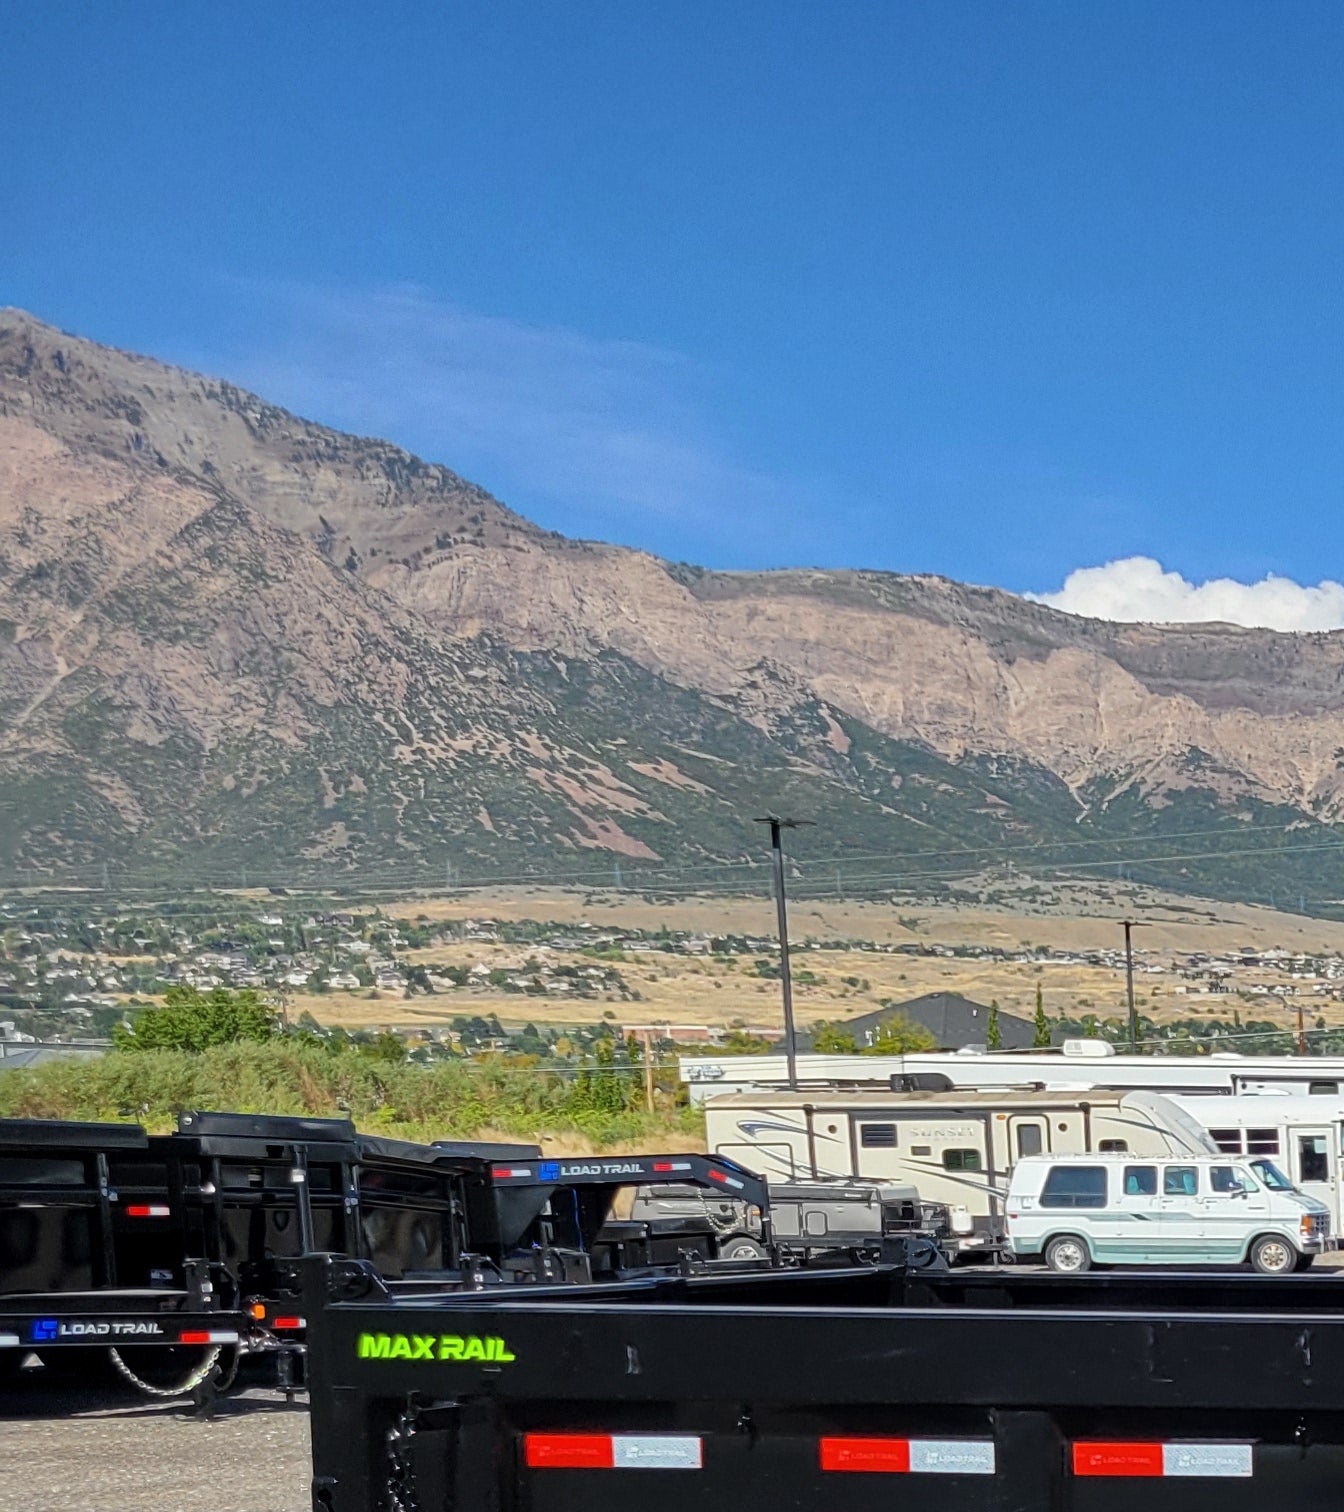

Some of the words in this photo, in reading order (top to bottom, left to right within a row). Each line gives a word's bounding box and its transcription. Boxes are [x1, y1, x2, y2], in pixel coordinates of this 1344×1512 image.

[61, 1323, 110, 1336] LOAD
[112, 1322, 164, 1335] TRAIL
[358, 1333, 436, 1361] MAX
[439, 1335, 516, 1362] RAIL
